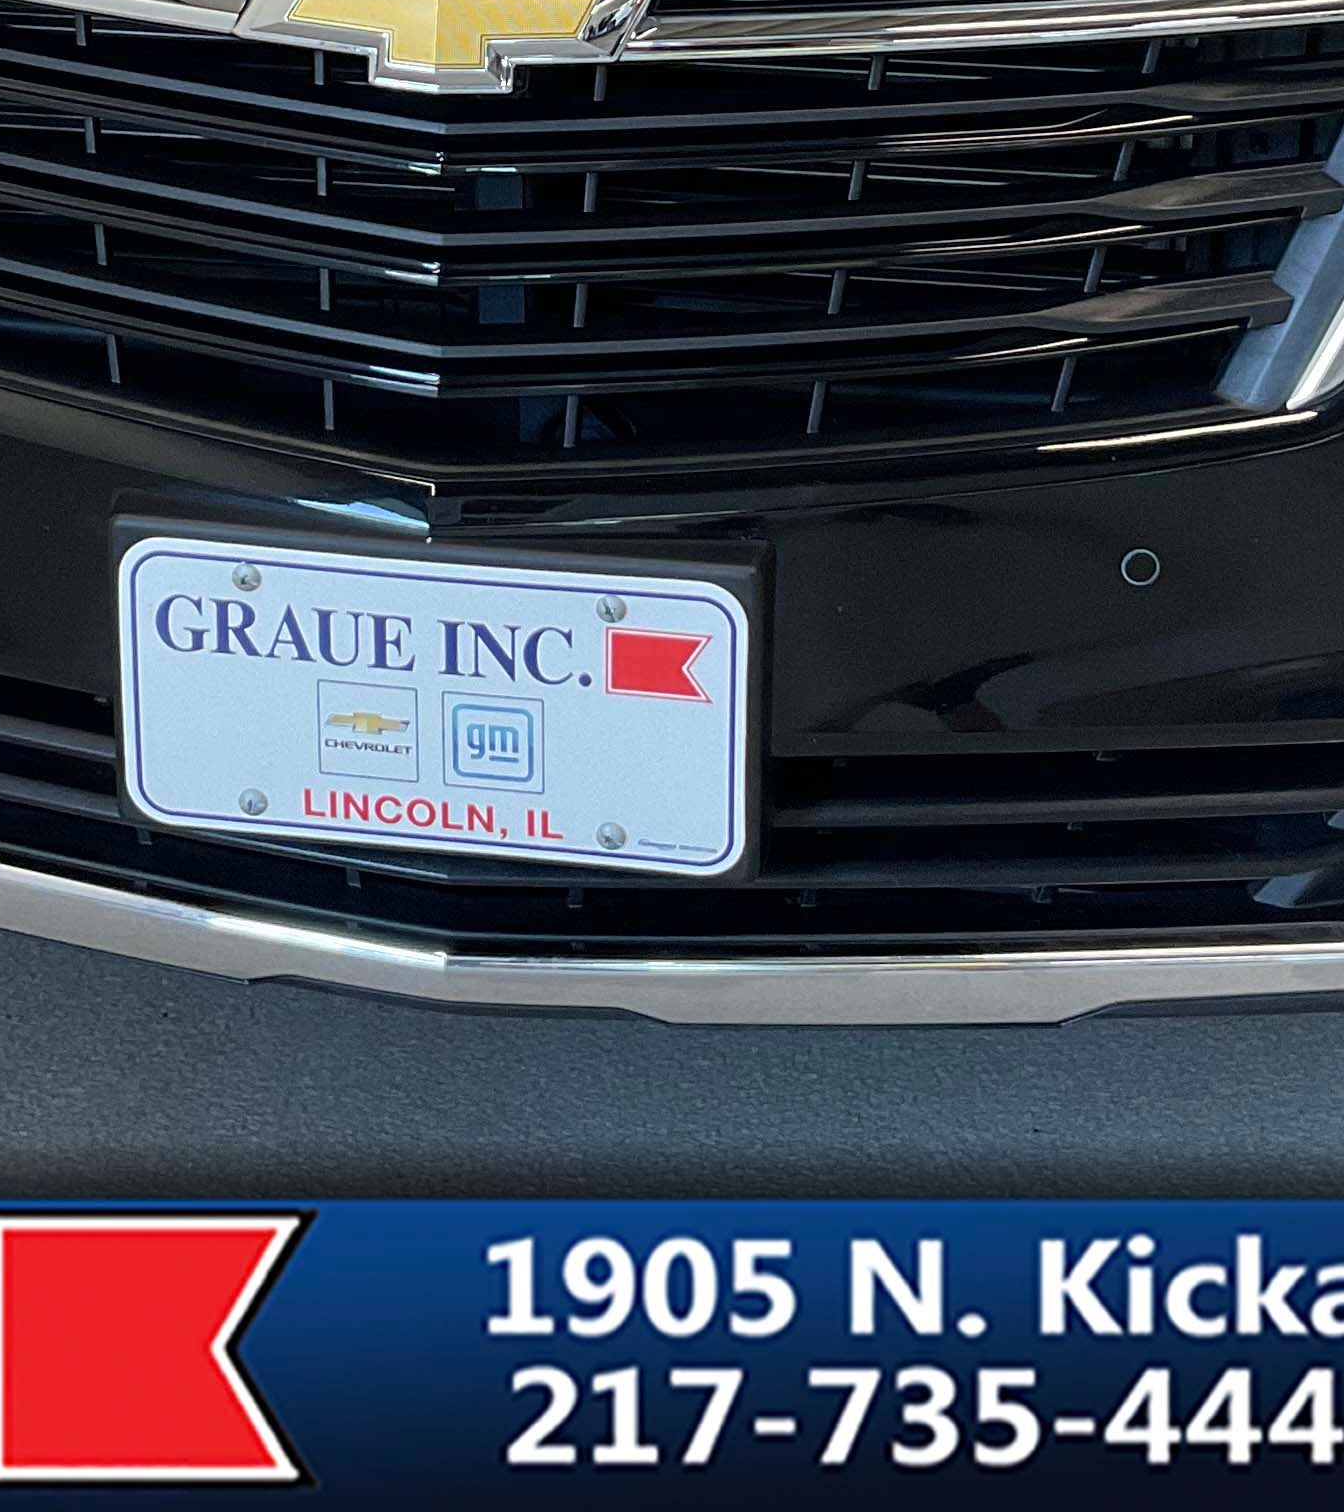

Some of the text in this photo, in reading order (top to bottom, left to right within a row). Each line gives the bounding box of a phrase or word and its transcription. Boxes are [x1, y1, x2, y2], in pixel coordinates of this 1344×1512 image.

[155, 594, 593, 688] GRAUE INC.
[324, 738, 413, 755] CHEVROLET
[466, 723, 519, 760] gm
[303, 789, 564, 840] LINCOLN, IL
